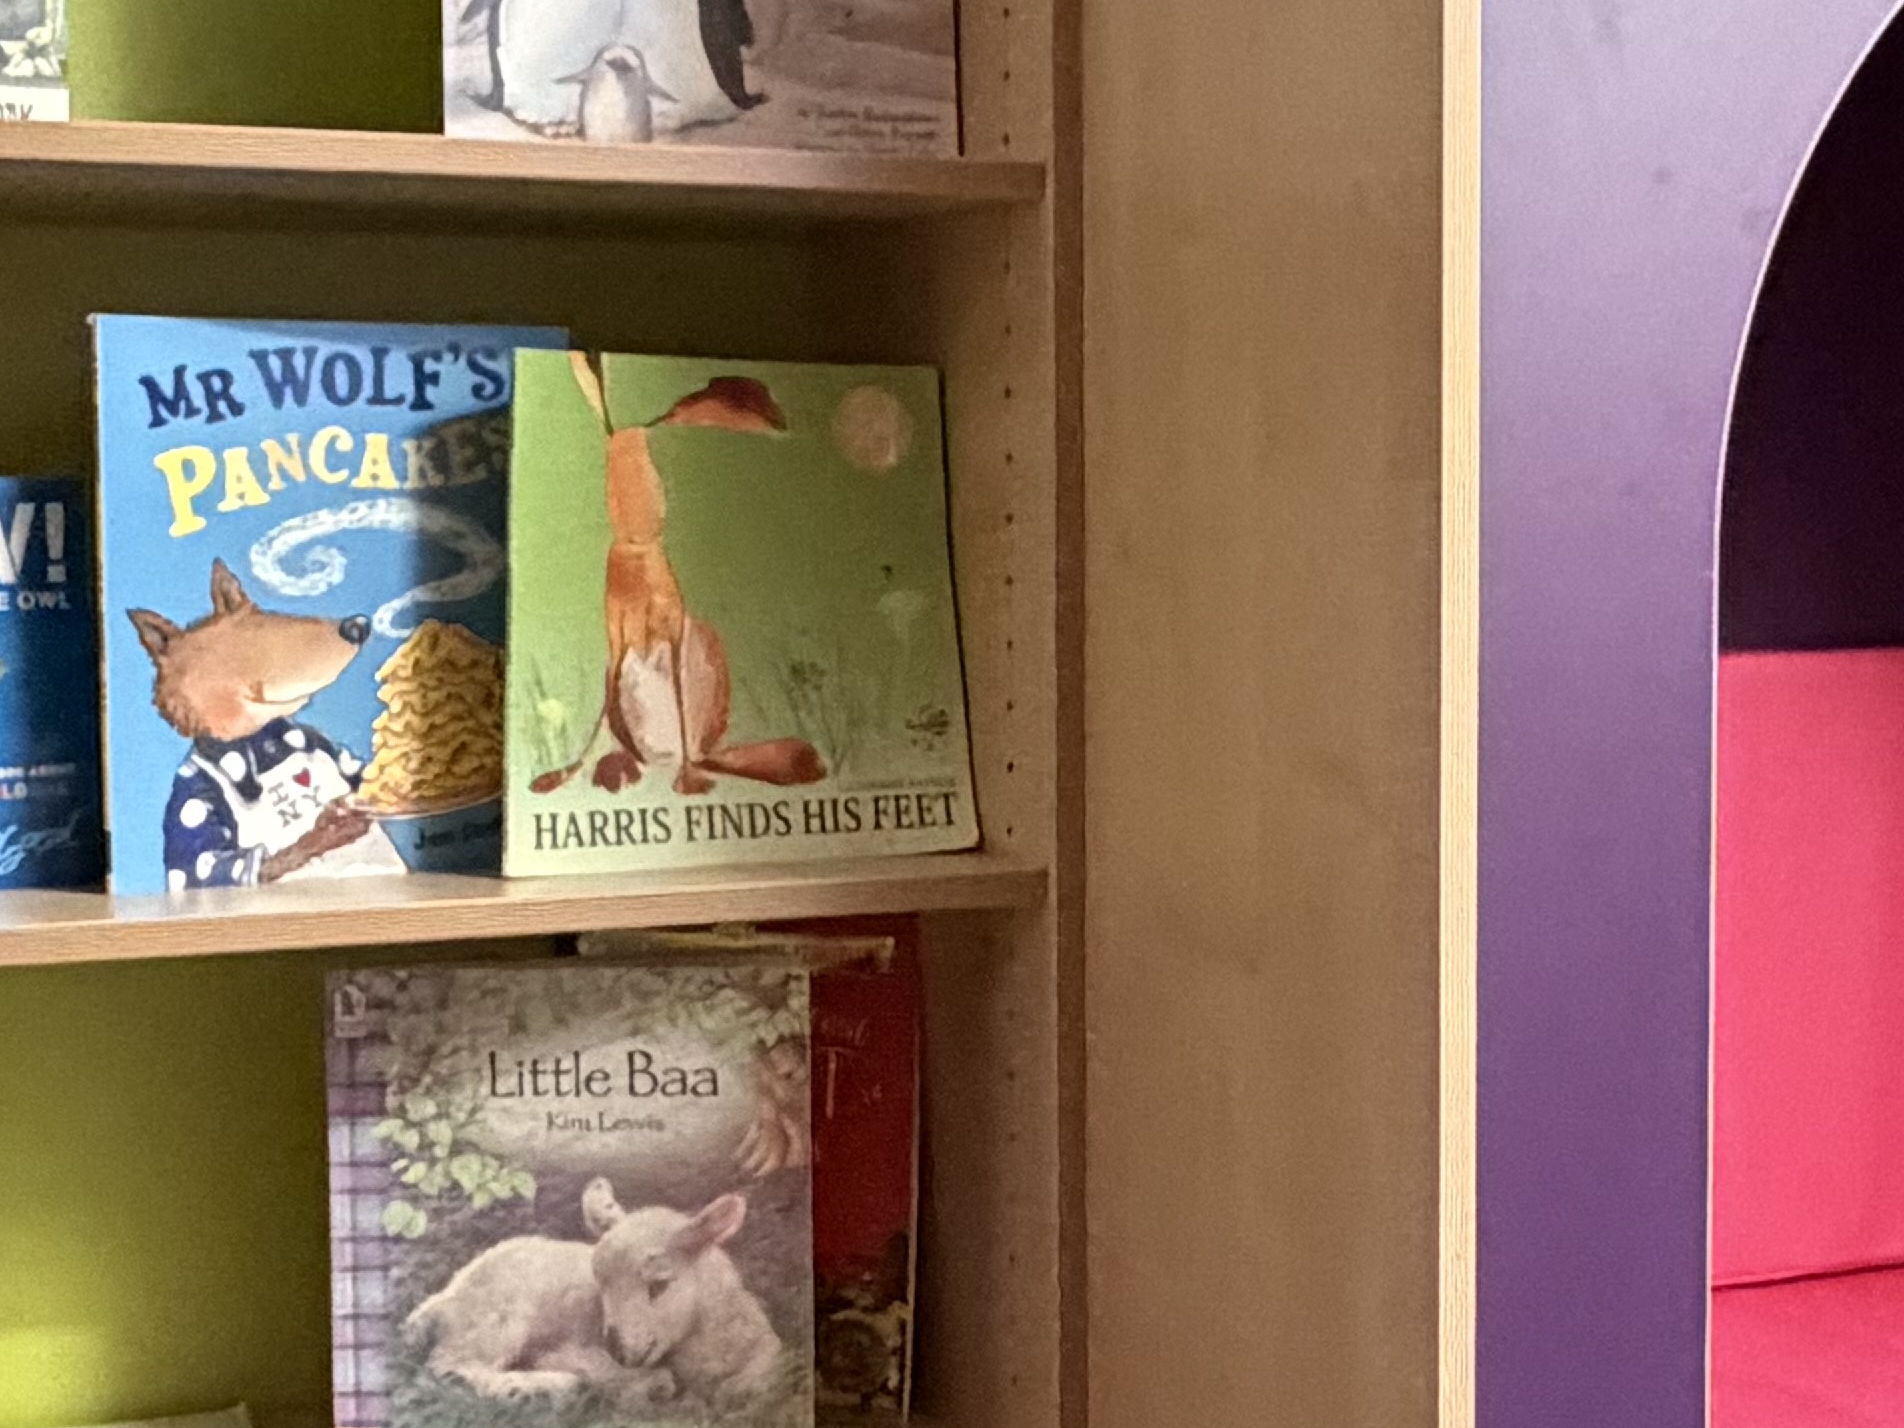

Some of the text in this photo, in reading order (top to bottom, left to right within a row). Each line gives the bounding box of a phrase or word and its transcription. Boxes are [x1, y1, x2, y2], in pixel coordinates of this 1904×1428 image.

[138, 341, 507, 429] MR WOLF'S
[17, 590, 72, 611] OWL
[533, 806, 672, 851] HARRIS
[685, 801, 793, 843] FINDS
[803, 796, 862, 835] HIS
[872, 790, 959, 831] FEET
[489, 1050, 719, 1098] Little Baa
